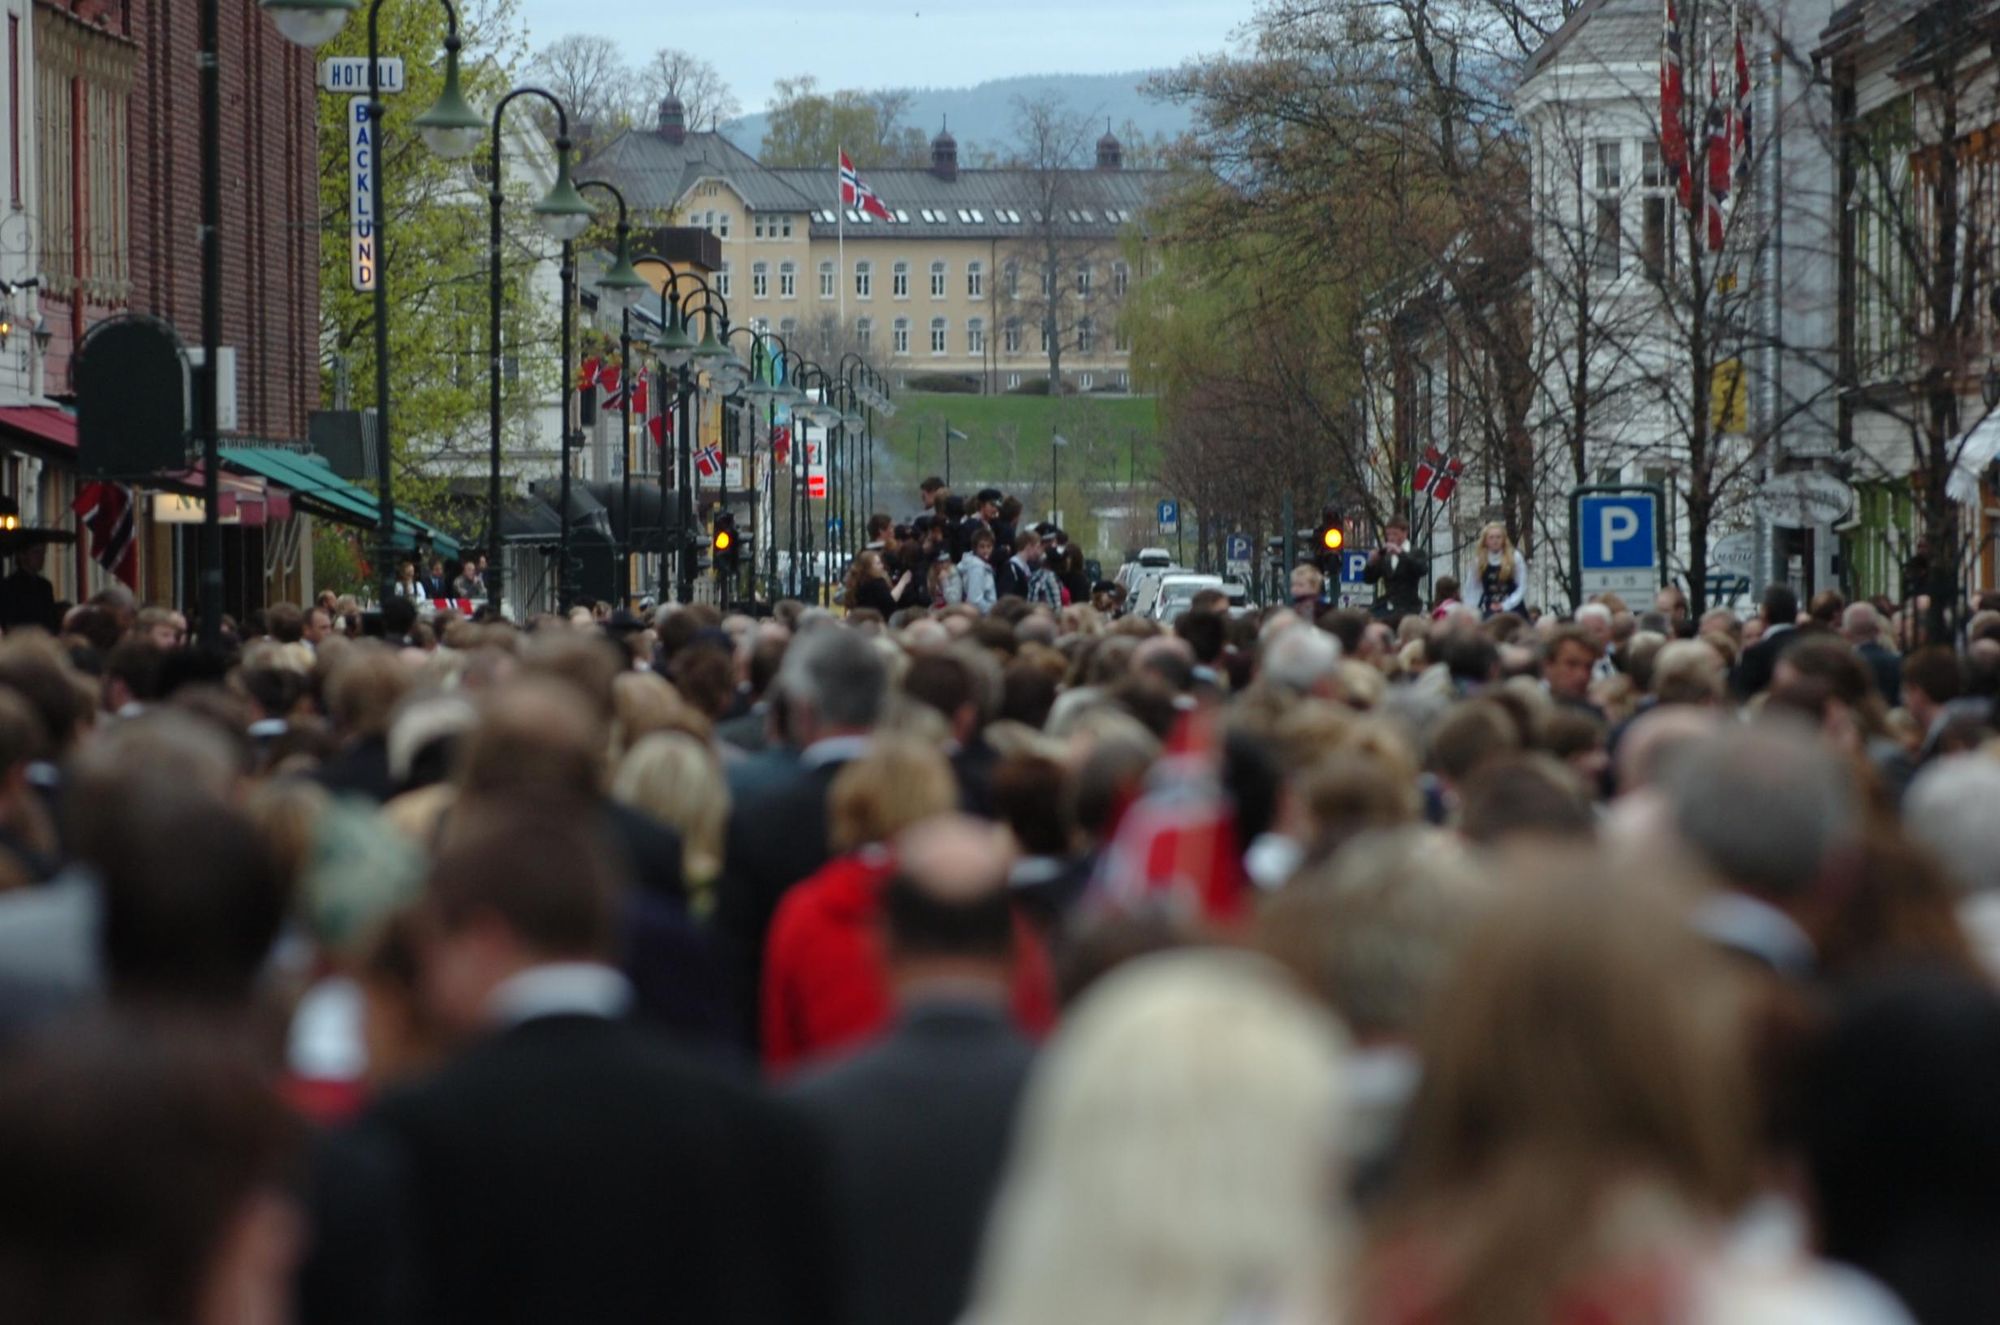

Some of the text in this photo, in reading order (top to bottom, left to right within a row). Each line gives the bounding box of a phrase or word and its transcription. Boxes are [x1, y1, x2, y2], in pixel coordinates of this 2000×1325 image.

[355, 104, 372, 284] BACKLUND
[1163, 504, 1173, 521] P
[1601, 506, 1639, 562] P
[1233, 538, 1247, 558] P
[1349, 554, 1367, 581] P
